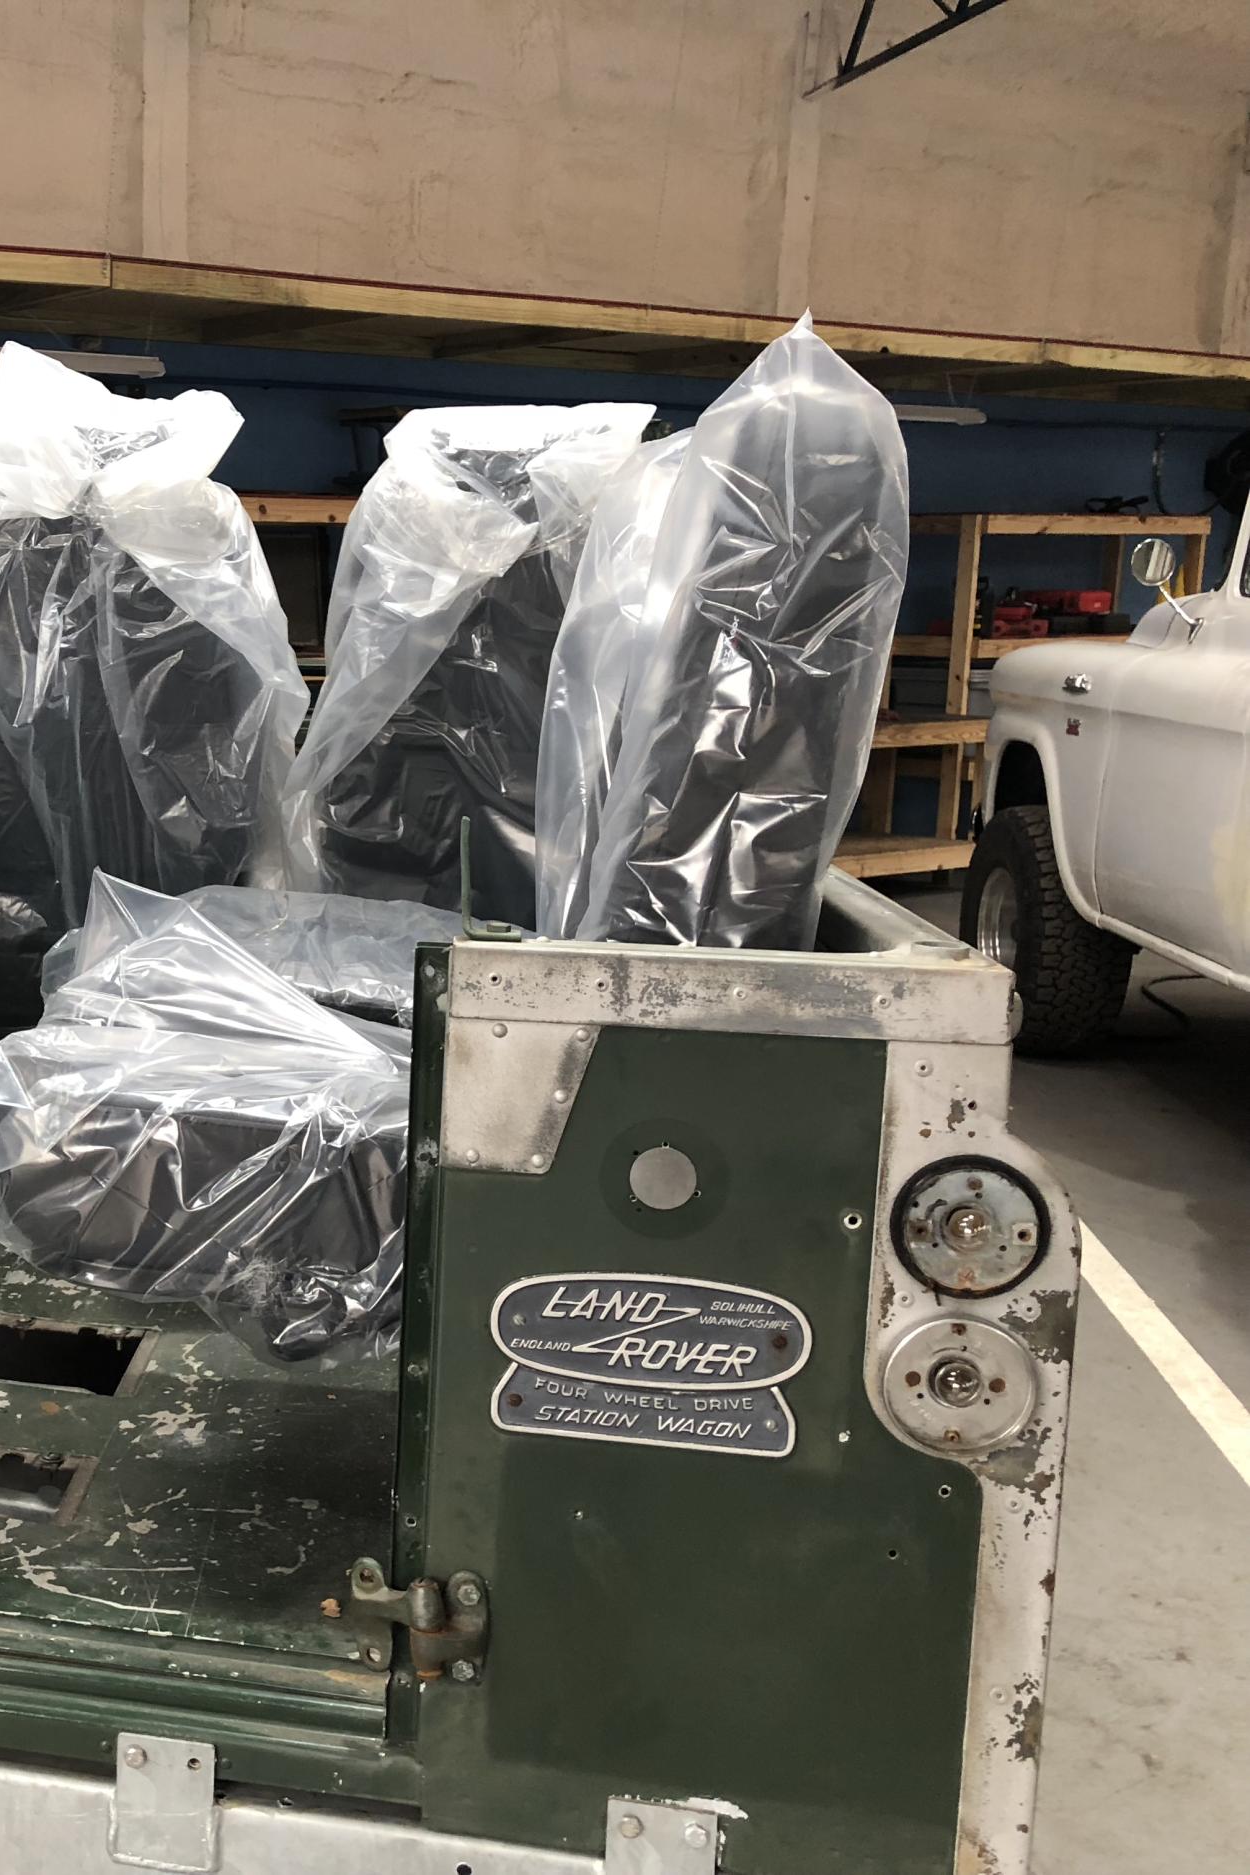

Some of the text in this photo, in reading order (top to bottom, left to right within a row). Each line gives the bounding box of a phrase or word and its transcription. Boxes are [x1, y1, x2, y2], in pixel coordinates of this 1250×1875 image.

[542, 1286, 668, 1324] LAND
[710, 1301, 776, 1315] SOLIHULL
[510, 1338, 571, 1352] ENGLAND
[607, 1336, 758, 1377] ROVER
[534, 1376, 754, 1412] FOUR WHEEL DRIVE
[534, 1405, 752, 1439] STATION WAGON
